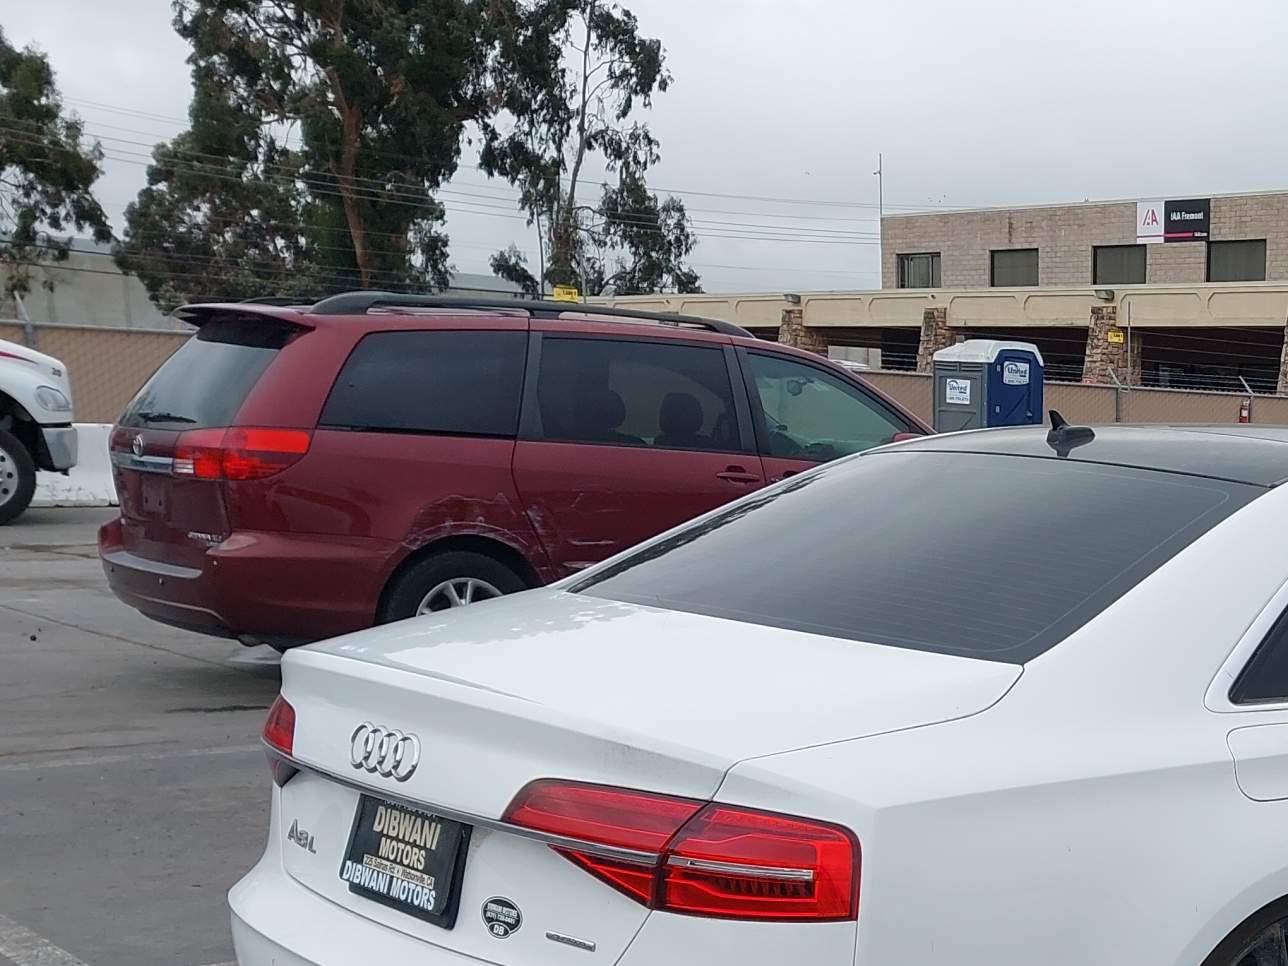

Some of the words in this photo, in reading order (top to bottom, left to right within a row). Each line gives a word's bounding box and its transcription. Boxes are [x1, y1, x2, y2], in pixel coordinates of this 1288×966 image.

[1181, 211, 1204, 220] Fremont
[373, 805, 441, 850] DIBWANI
[378, 837, 426, 870] MOTORS
[342, 860, 391, 895] DIBWANI
[390, 878, 436, 911] MOTORS
